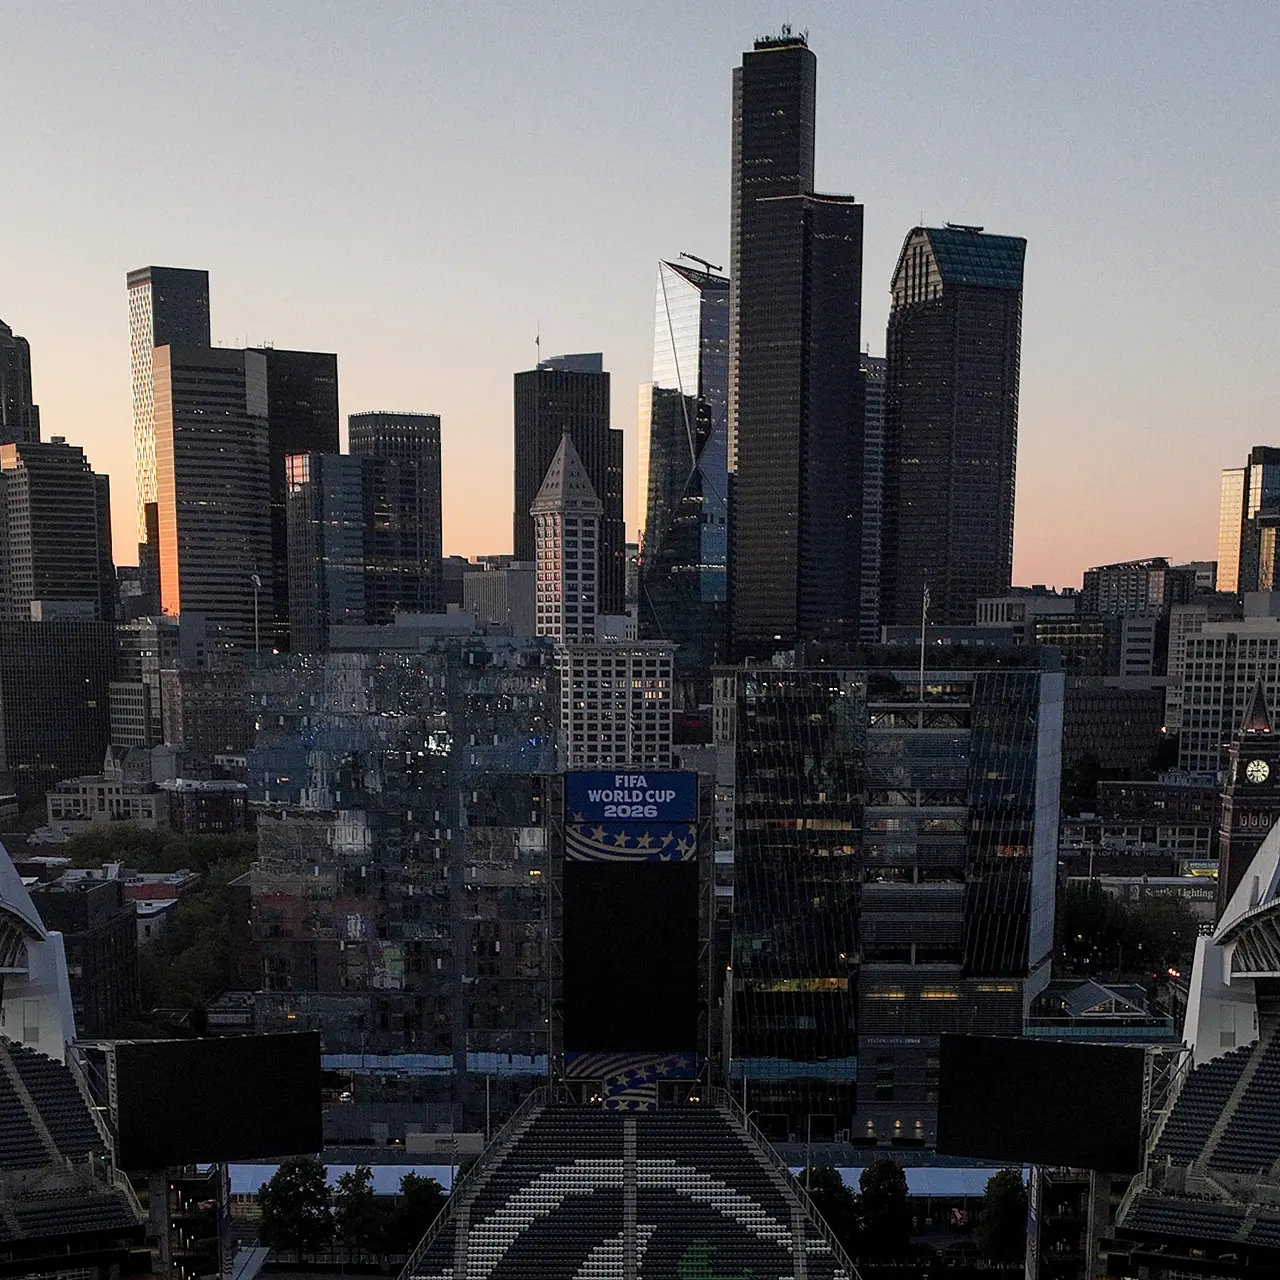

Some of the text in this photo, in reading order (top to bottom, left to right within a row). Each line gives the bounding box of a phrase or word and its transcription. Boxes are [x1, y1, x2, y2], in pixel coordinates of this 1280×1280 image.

[615, 774, 648, 788] FIFA
[587, 789, 676, 803] WORLD CUP
[603, 805, 658, 818] 2026
[1177, 888, 1214, 899] Lighting
